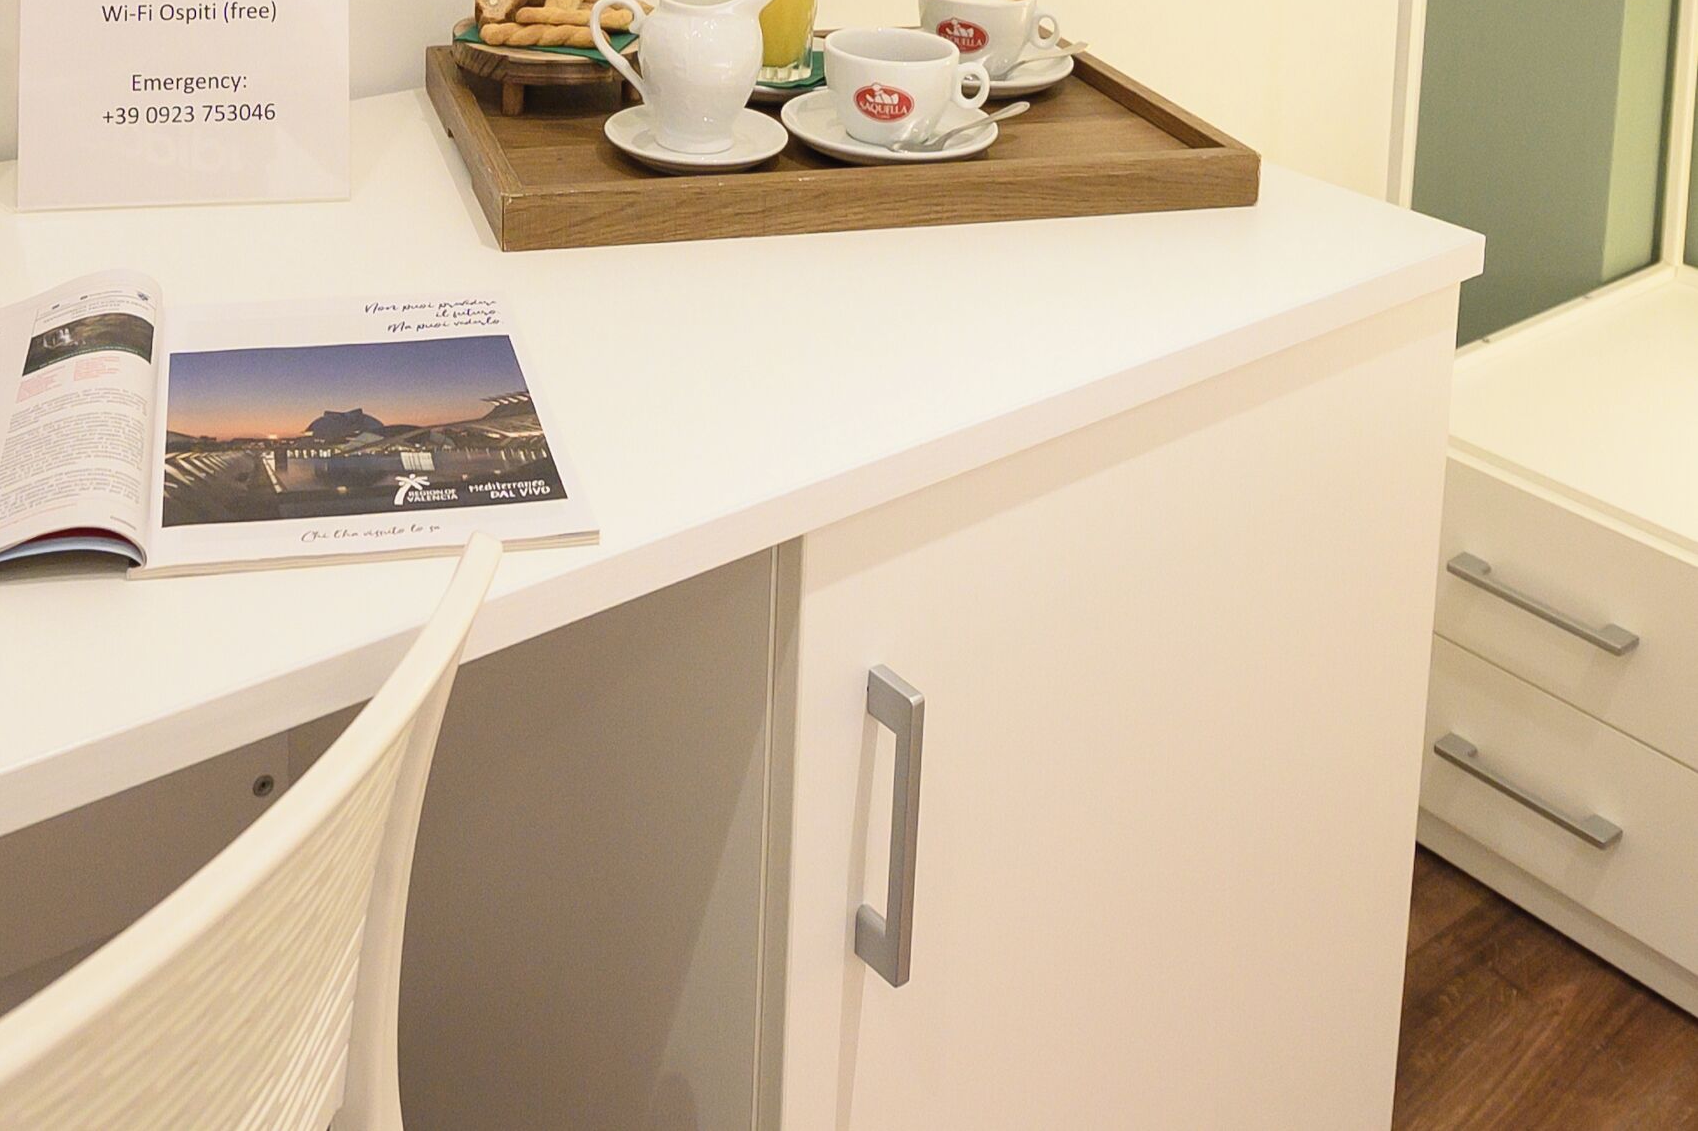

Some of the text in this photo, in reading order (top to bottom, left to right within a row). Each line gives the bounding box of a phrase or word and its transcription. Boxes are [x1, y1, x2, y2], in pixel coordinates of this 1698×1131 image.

[101, 1, 277, 24] Wi-Fi Ospiti (free)
[131, 74, 247, 94] Emergency:
[101, 103, 276, 125] +39 0923 753046
[406, 494, 459, 503] VALENCIA
[490, 486, 551, 499] DAL VIVO
